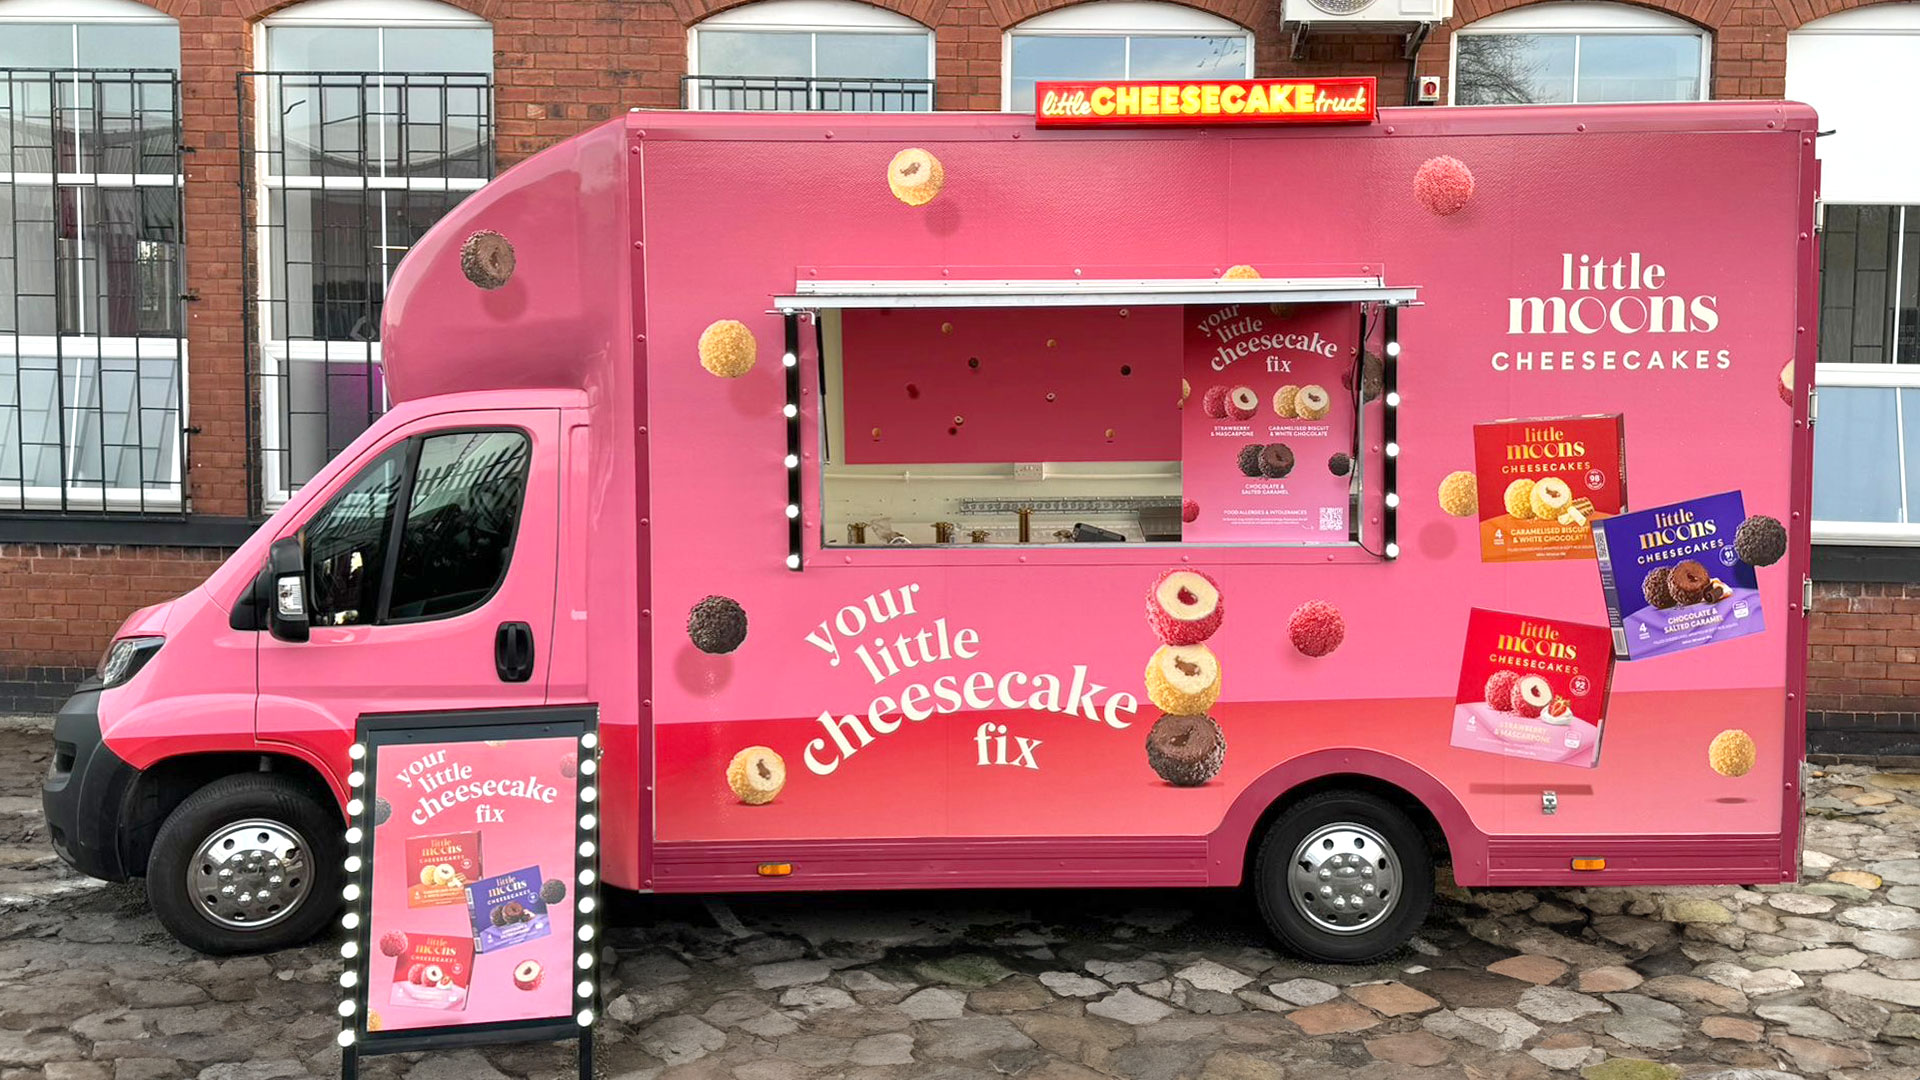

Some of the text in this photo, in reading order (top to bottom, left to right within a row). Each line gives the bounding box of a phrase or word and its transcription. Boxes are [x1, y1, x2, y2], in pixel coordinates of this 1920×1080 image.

[1042, 85, 1367, 116] little CHEESECAKE truck
[1560, 252, 1666, 291] little
[1198, 303, 1240, 337] your
[1506, 295, 1719, 334] moons
[1216, 317, 1263, 344] little
[1211, 333, 1338, 372] cheesecake
[1491, 350, 1731, 371] CHEESECAKES
[1266, 355, 1292, 373] fix
[1525, 426, 1564, 442] little
[1506, 441, 1586, 460] moons
[1502, 461, 1591, 474] CHEESECAKES
[1589, 474, 1600, 483] 98
[1654, 508, 1694, 529] little
[1495, 529, 1503, 539] 4
[1510, 527, 1560, 536] CARAMELISED
[1638, 519, 1717, 550] moons
[1637, 538, 1724, 565] CHEESECAKES
[803, 583, 920, 667] your
[1639, 622, 1648, 632] 4
[1664, 623, 1690, 634] SALTED
[1690, 615, 1724, 628] CARAMEL
[1667, 610, 1711, 625] CHOCOLATE
[1520, 621, 1560, 641] little
[854, 618, 980, 685] little
[1497, 634, 1577, 660] moons
[1489, 654, 1579, 675] CHEESECAKES
[1574, 680, 1586, 689] 92
[803, 665, 1138, 776] cheesecake
[1468, 715, 1476, 725] 4
[973, 722, 1044, 770] fix
[395, 749, 446, 788] your
[418, 762, 473, 794] little
[411, 776, 557, 825] cheesecake
[475, 804, 505, 823] fix
